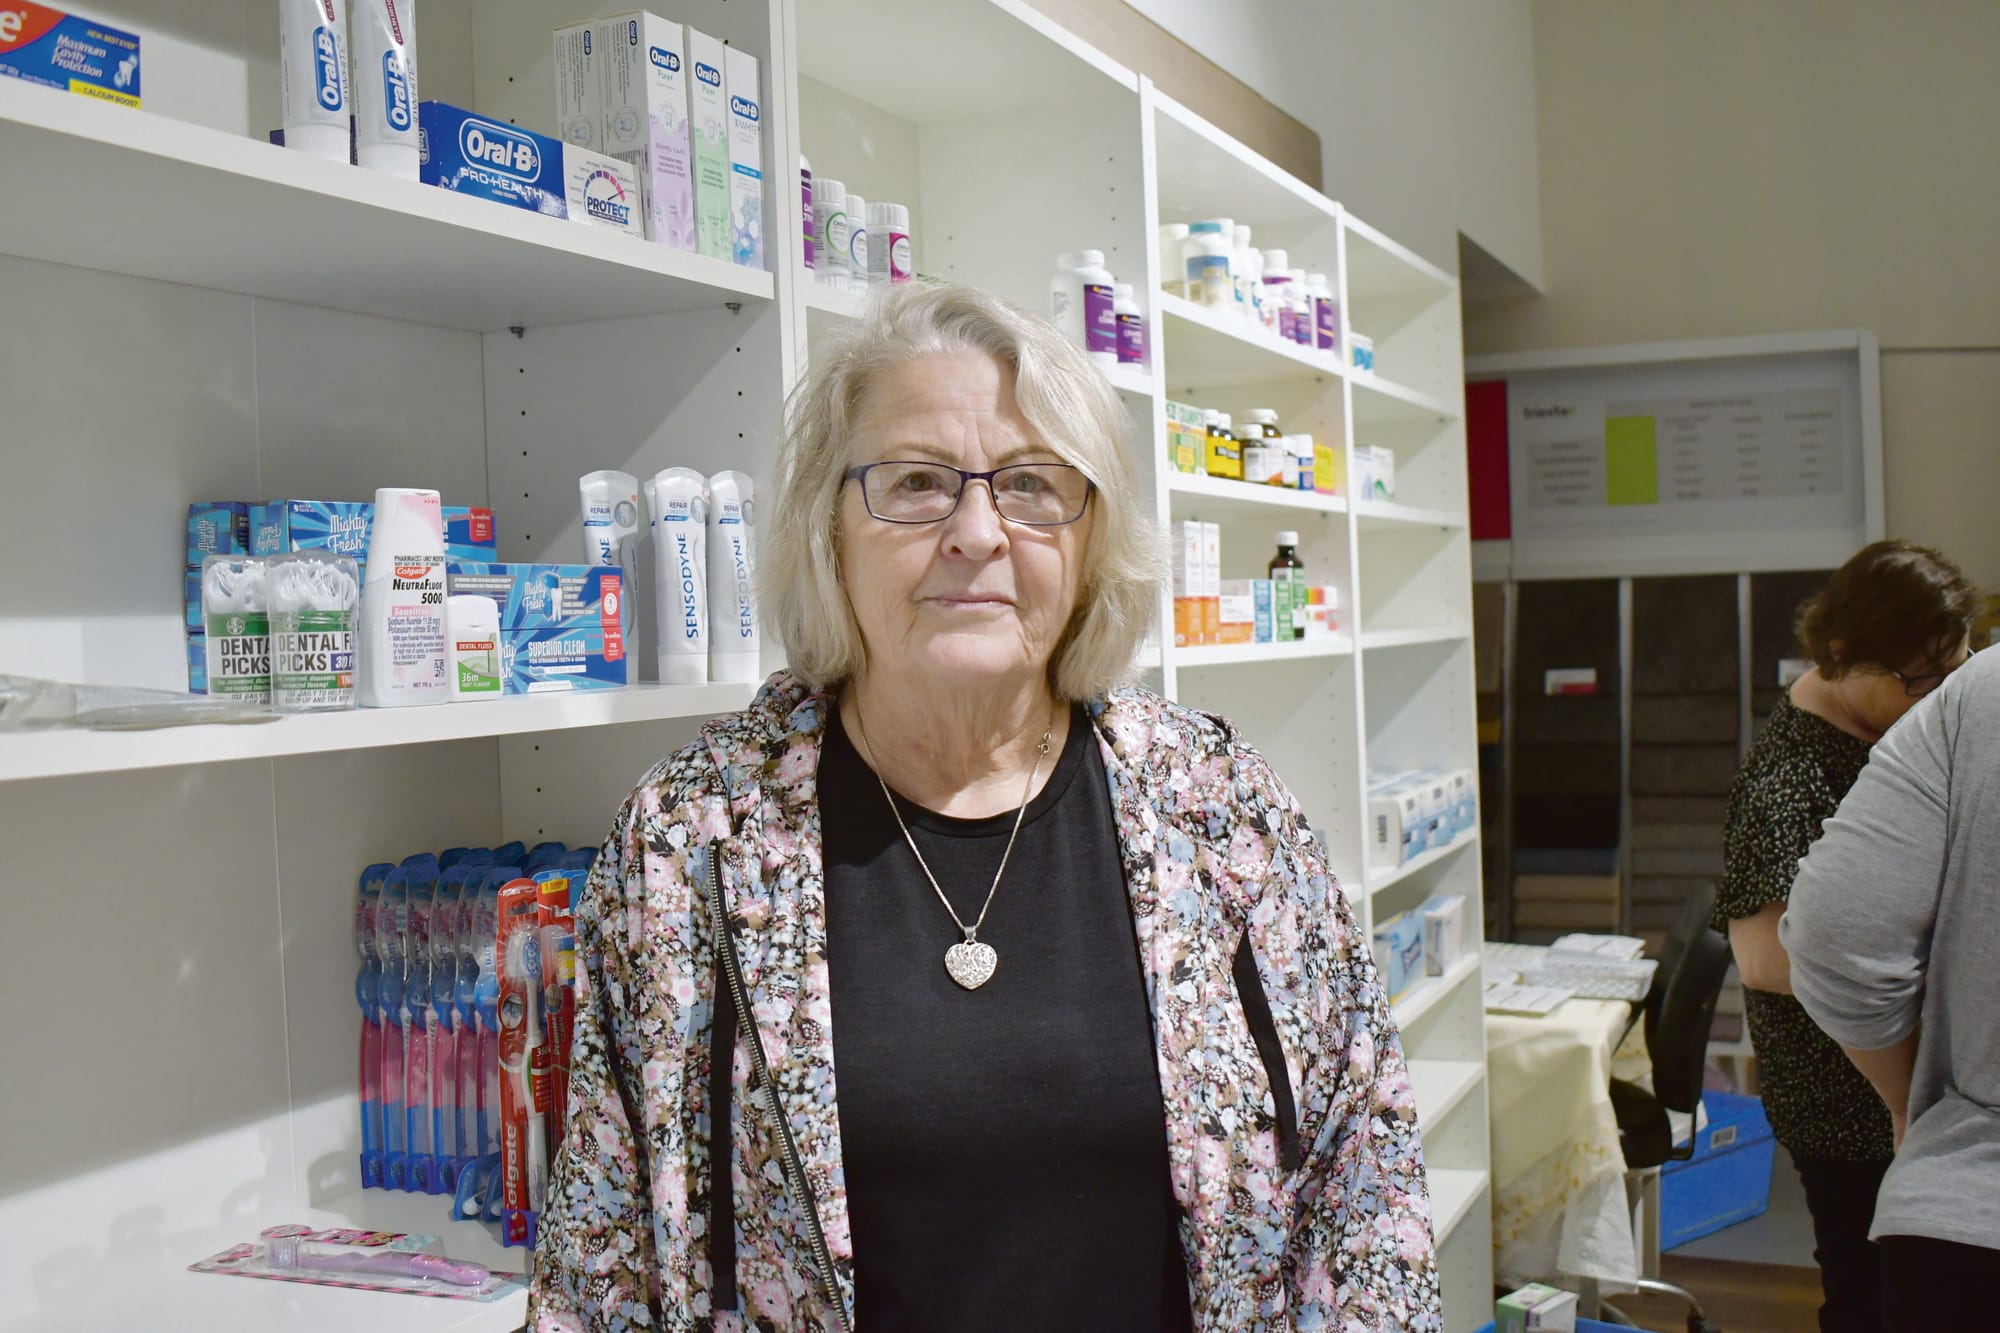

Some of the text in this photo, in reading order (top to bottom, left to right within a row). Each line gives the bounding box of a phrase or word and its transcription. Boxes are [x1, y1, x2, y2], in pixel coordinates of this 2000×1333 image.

[55, 46, 86, 62] Cavity
[57, 34, 107, 58] Maximum
[51, 55, 103, 78] Protection
[651, 49, 678, 68] Oral-B
[318, 33, 340, 106] Oral-B
[696, 65, 719, 82] Oral-B
[84, 87, 115, 103] CALCIUM
[388, 57, 408, 126] Oral-B
[732, 98, 758, 118] Oral-B
[466, 129, 534, 172] Oral-B
[587, 196, 630, 218] PROTECT
[669, 501, 688, 509] REPAIR
[330, 512, 369, 539] Mighty
[327, 532, 364, 554] Fresh
[676, 532, 699, 639] SENSODYNE
[731, 535, 753, 638] SENSODYNE
[421, 592, 443, 605] 5000
[221, 637, 270, 656] DENTA
[279, 632, 339, 653] DENTAL
[528, 641, 562, 657] SUPERIOR
[564, 639, 586, 655] CLEAN
[221, 656, 270, 675] PICKS
[280, 653, 327, 672] PICKS
[462, 673, 478, 681] 36m
